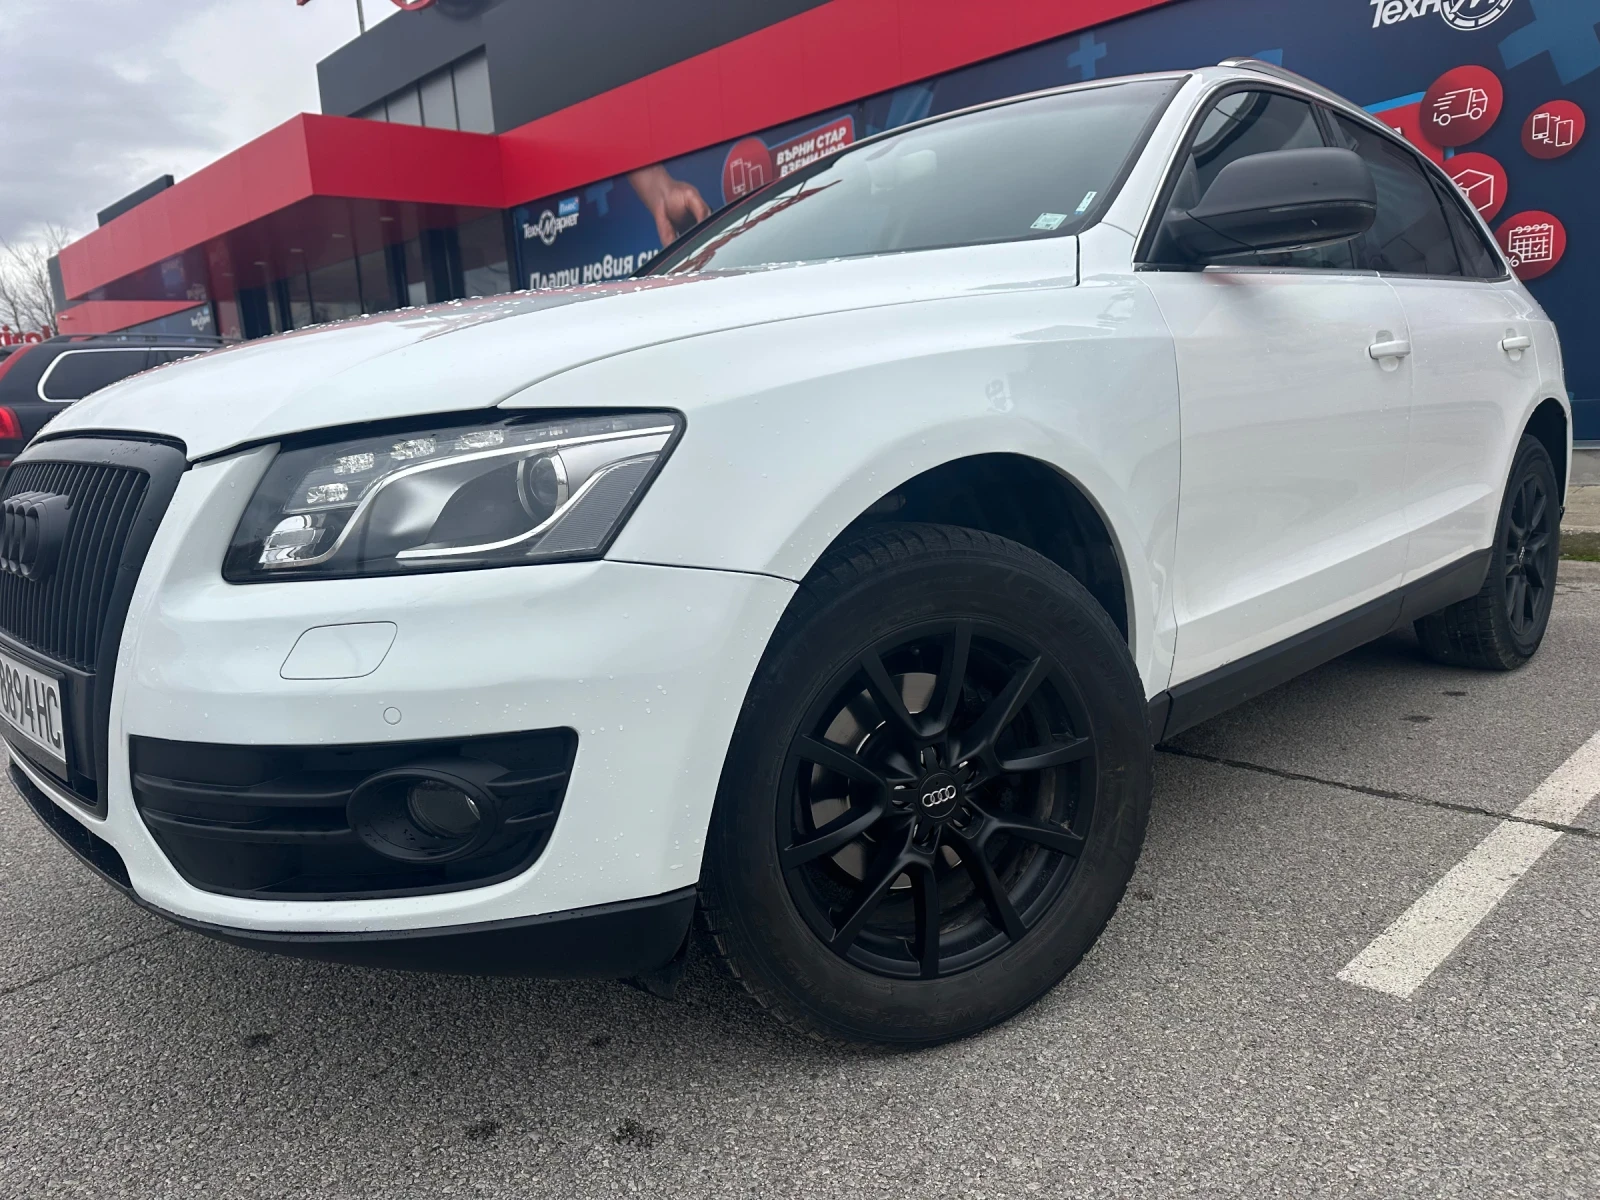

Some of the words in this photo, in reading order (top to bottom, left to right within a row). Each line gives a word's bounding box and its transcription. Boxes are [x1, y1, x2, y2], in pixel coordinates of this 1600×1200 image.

[776, 138, 815, 166] ВЪРНИ
[816, 126, 847, 149] СТАР
[530, 267, 580, 290] Плати
[583, 254, 634, 282] новия
